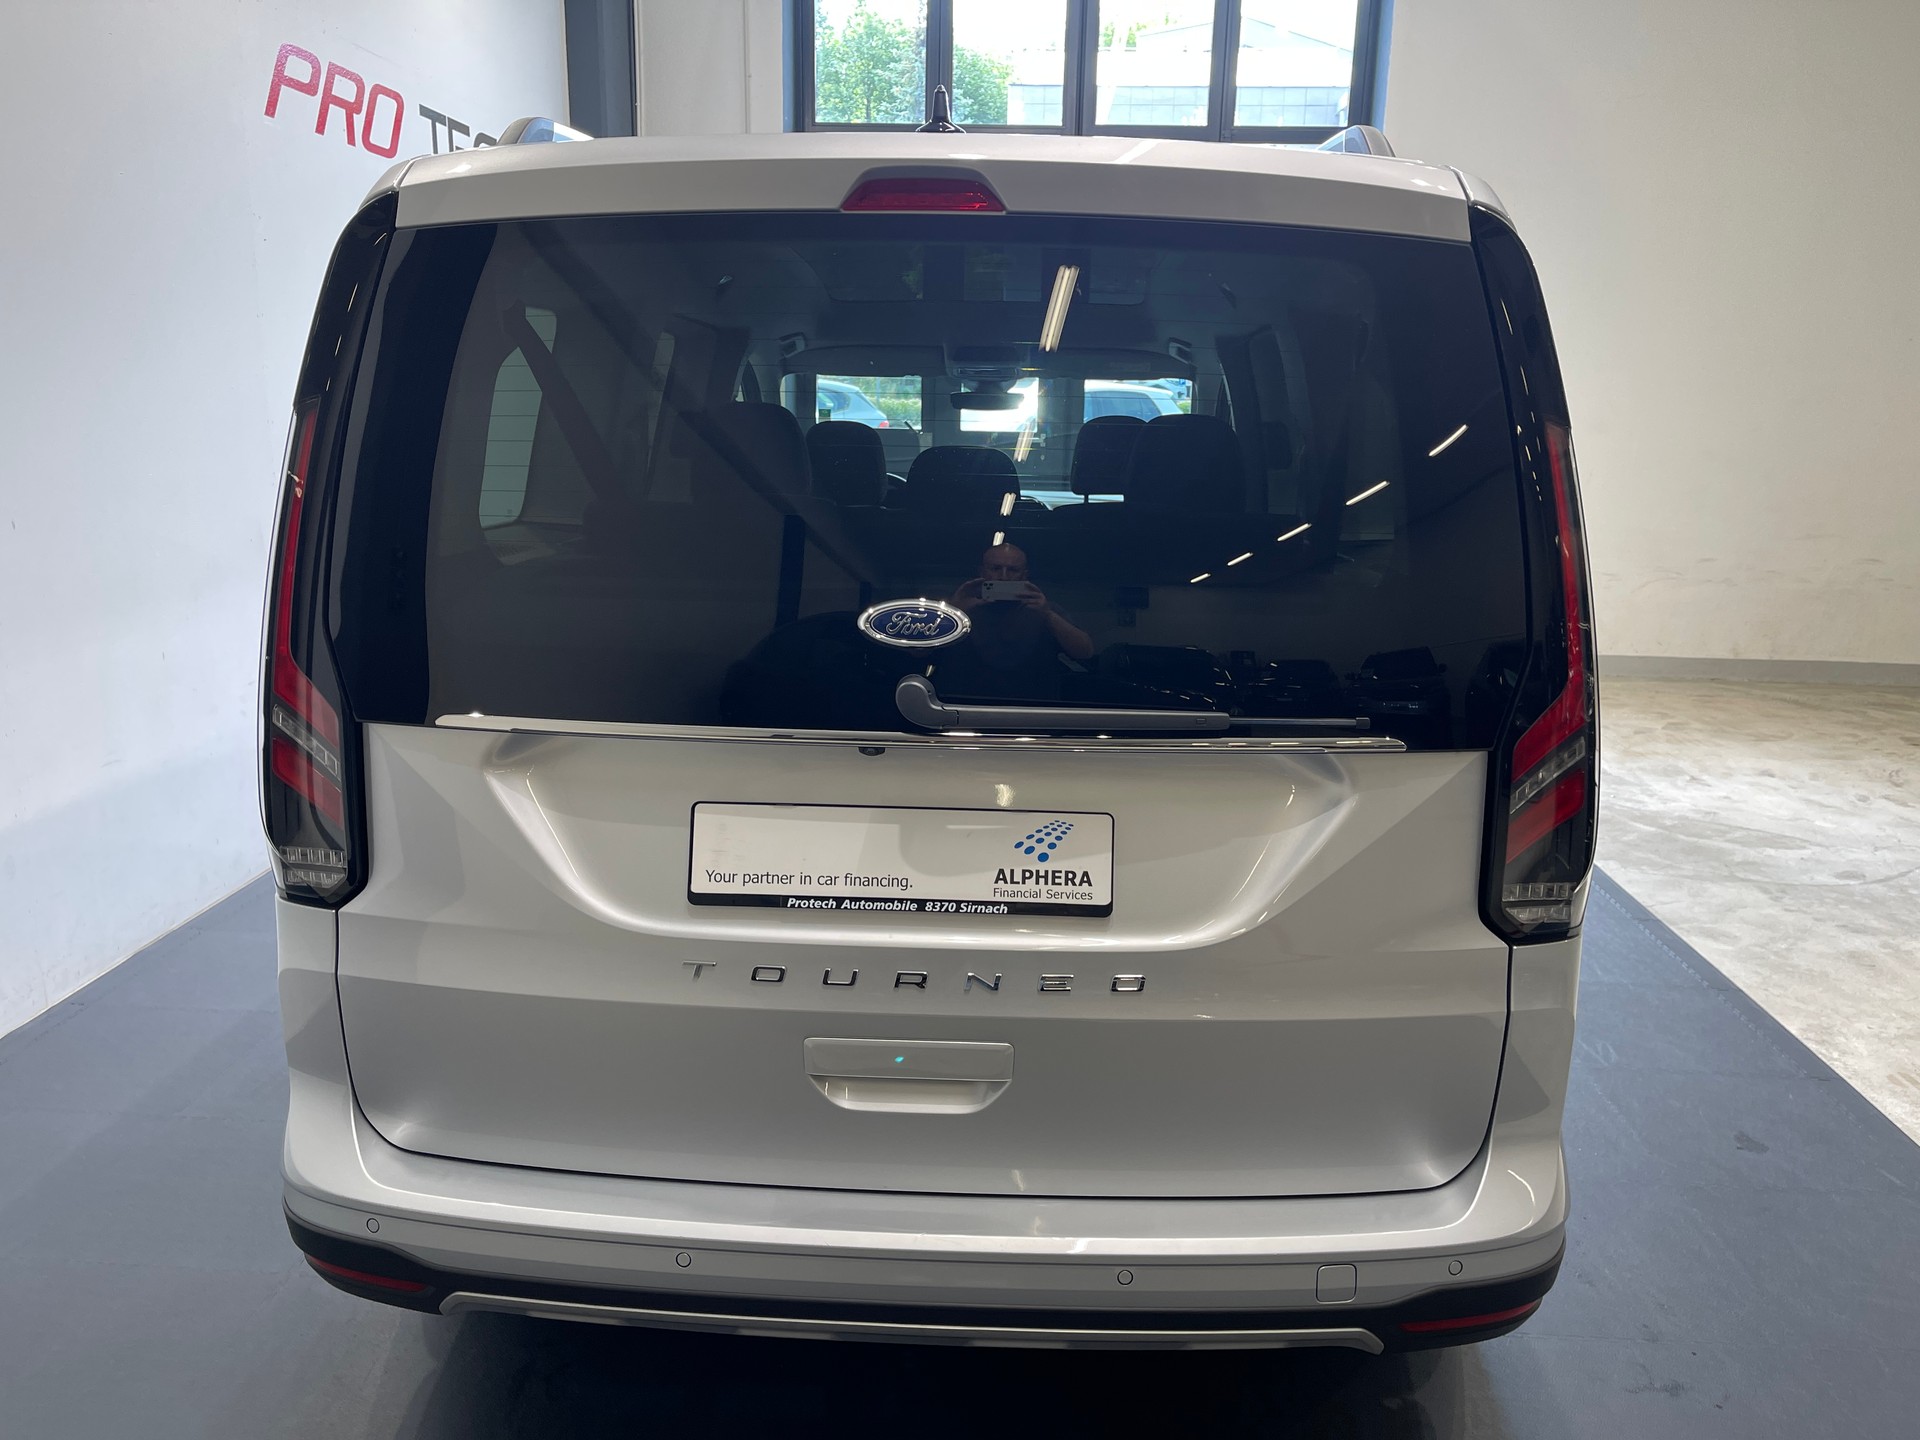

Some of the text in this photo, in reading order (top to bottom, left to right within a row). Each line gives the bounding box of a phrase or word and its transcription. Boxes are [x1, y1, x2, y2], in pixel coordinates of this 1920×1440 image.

[264, 43, 404, 159] PRO
[885, 611, 944, 636] Ford
[706, 870, 913, 891] Your partner in car financing.
[994, 868, 1093, 887] ALPHERA
[993, 888, 1093, 900] Financial Services
[787, 898, 1008, 914] Protech Automobile 8370 Sirnach
[682, 959, 1147, 994] TOURNEO
